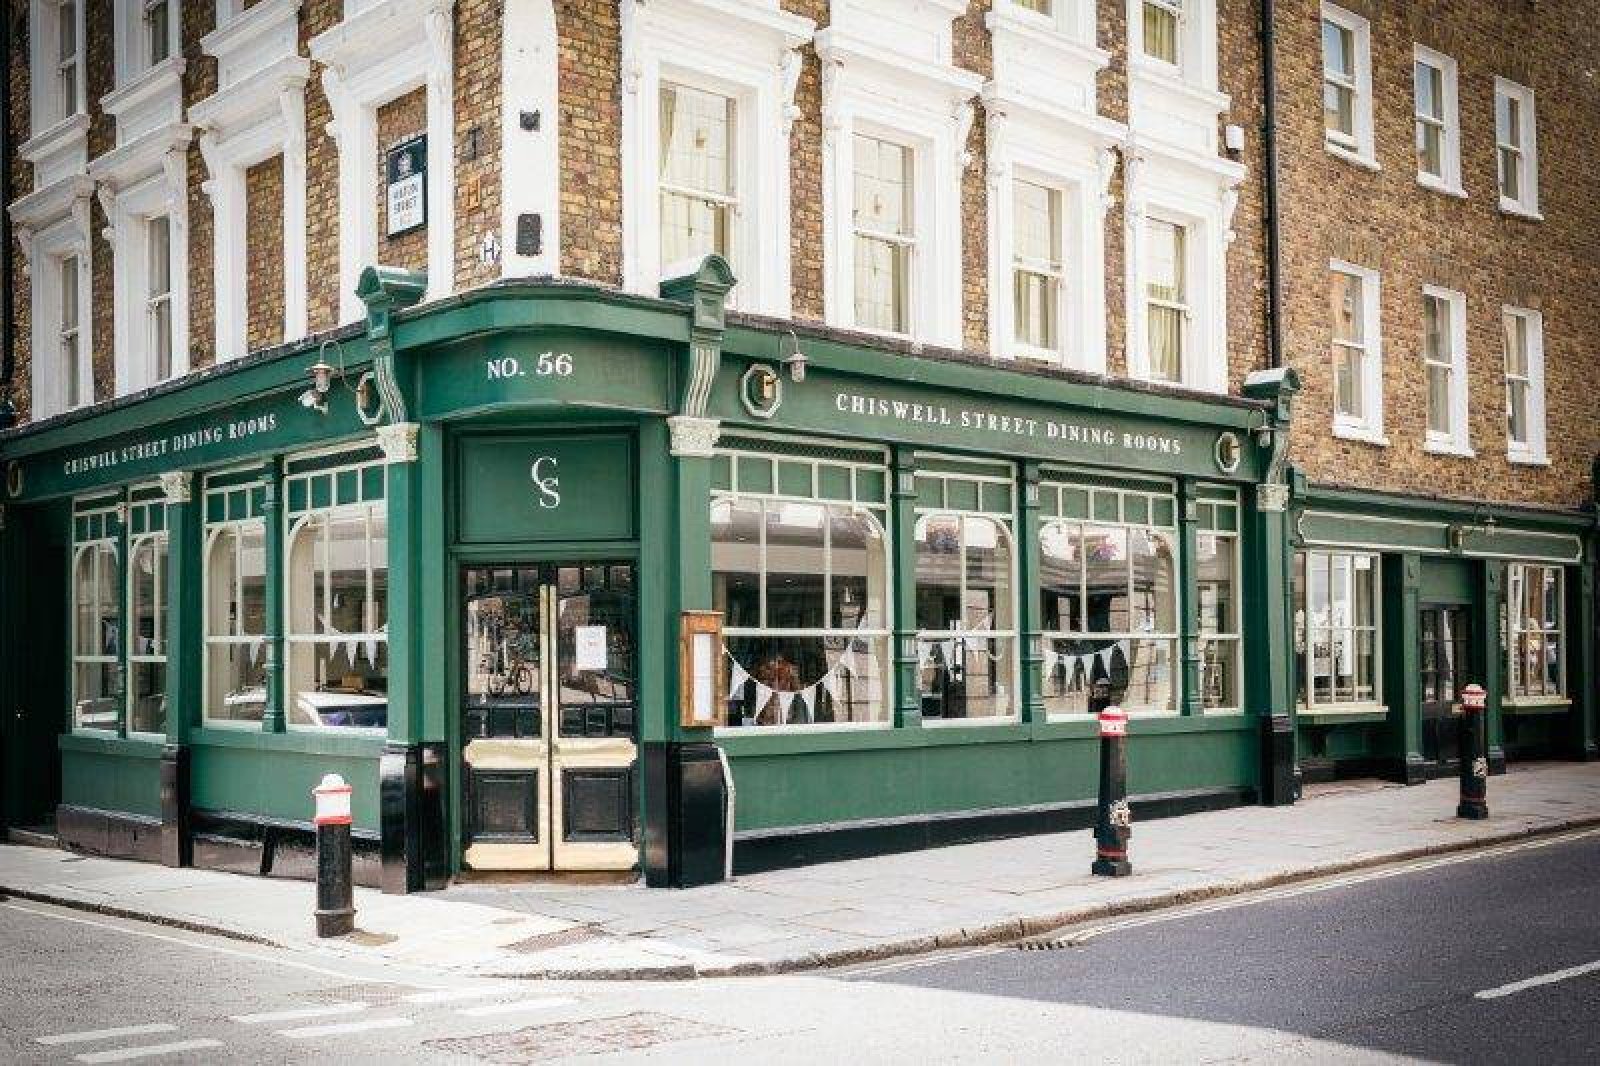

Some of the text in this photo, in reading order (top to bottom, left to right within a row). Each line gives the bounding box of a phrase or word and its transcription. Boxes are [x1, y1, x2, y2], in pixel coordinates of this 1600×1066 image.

[487, 351, 573, 381] NO. 56
[64, 412, 277, 476] CHISWELL STREET DINING ROOMS
[835, 393, 1182, 456] CHISWELL STREET DINING ROOMS
